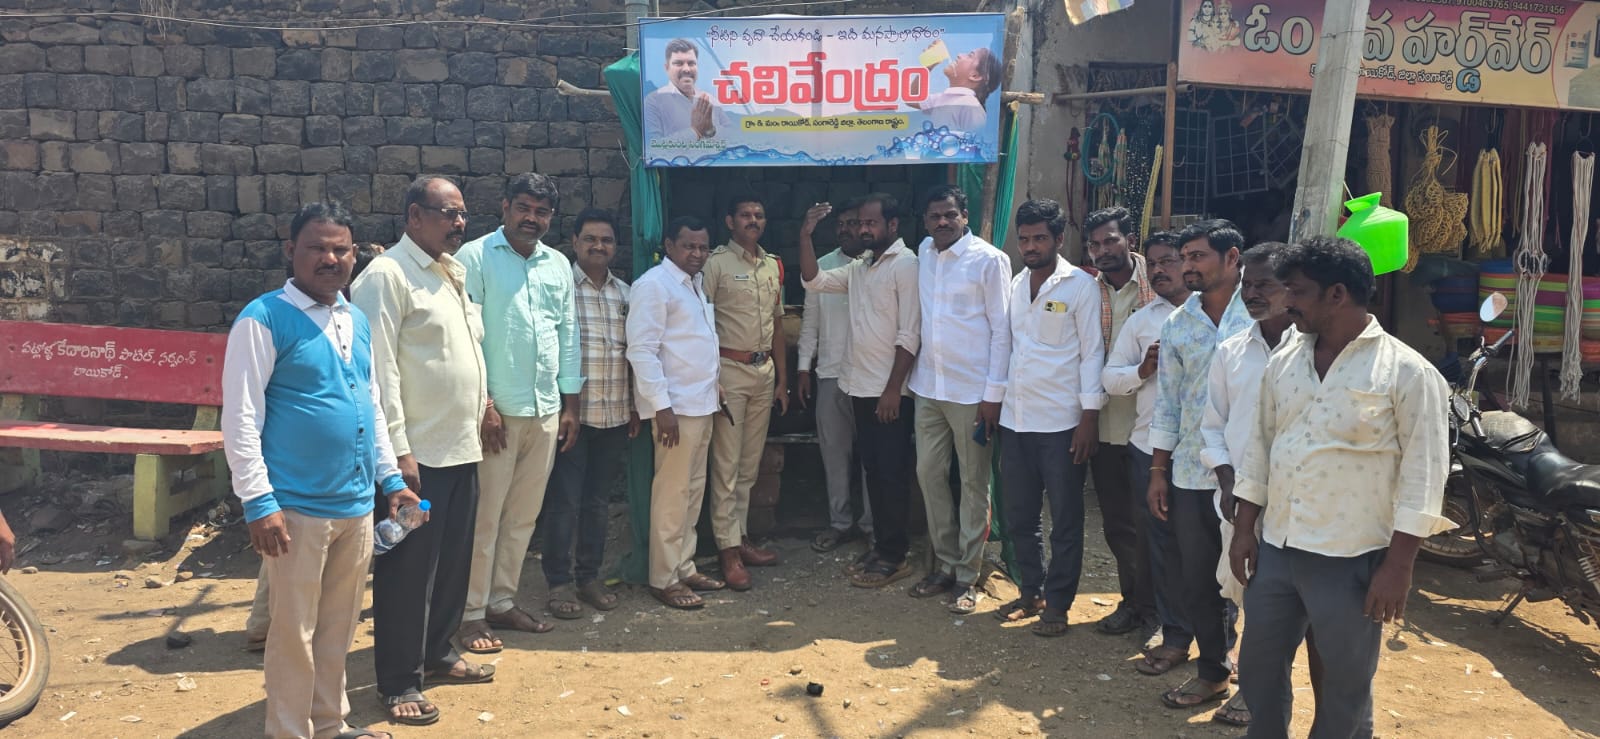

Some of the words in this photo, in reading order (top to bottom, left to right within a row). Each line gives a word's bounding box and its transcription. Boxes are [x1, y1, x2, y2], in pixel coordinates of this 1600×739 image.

[1512, 2, 1566, 15] 9441721456
[838, 27, 858, 40] ఇది
[1243, 4, 1314, 55] ఓం
[713, 51, 930, 111] చలివేంద్రం
[1417, 69, 1453, 90] సంగారెడ్డి
